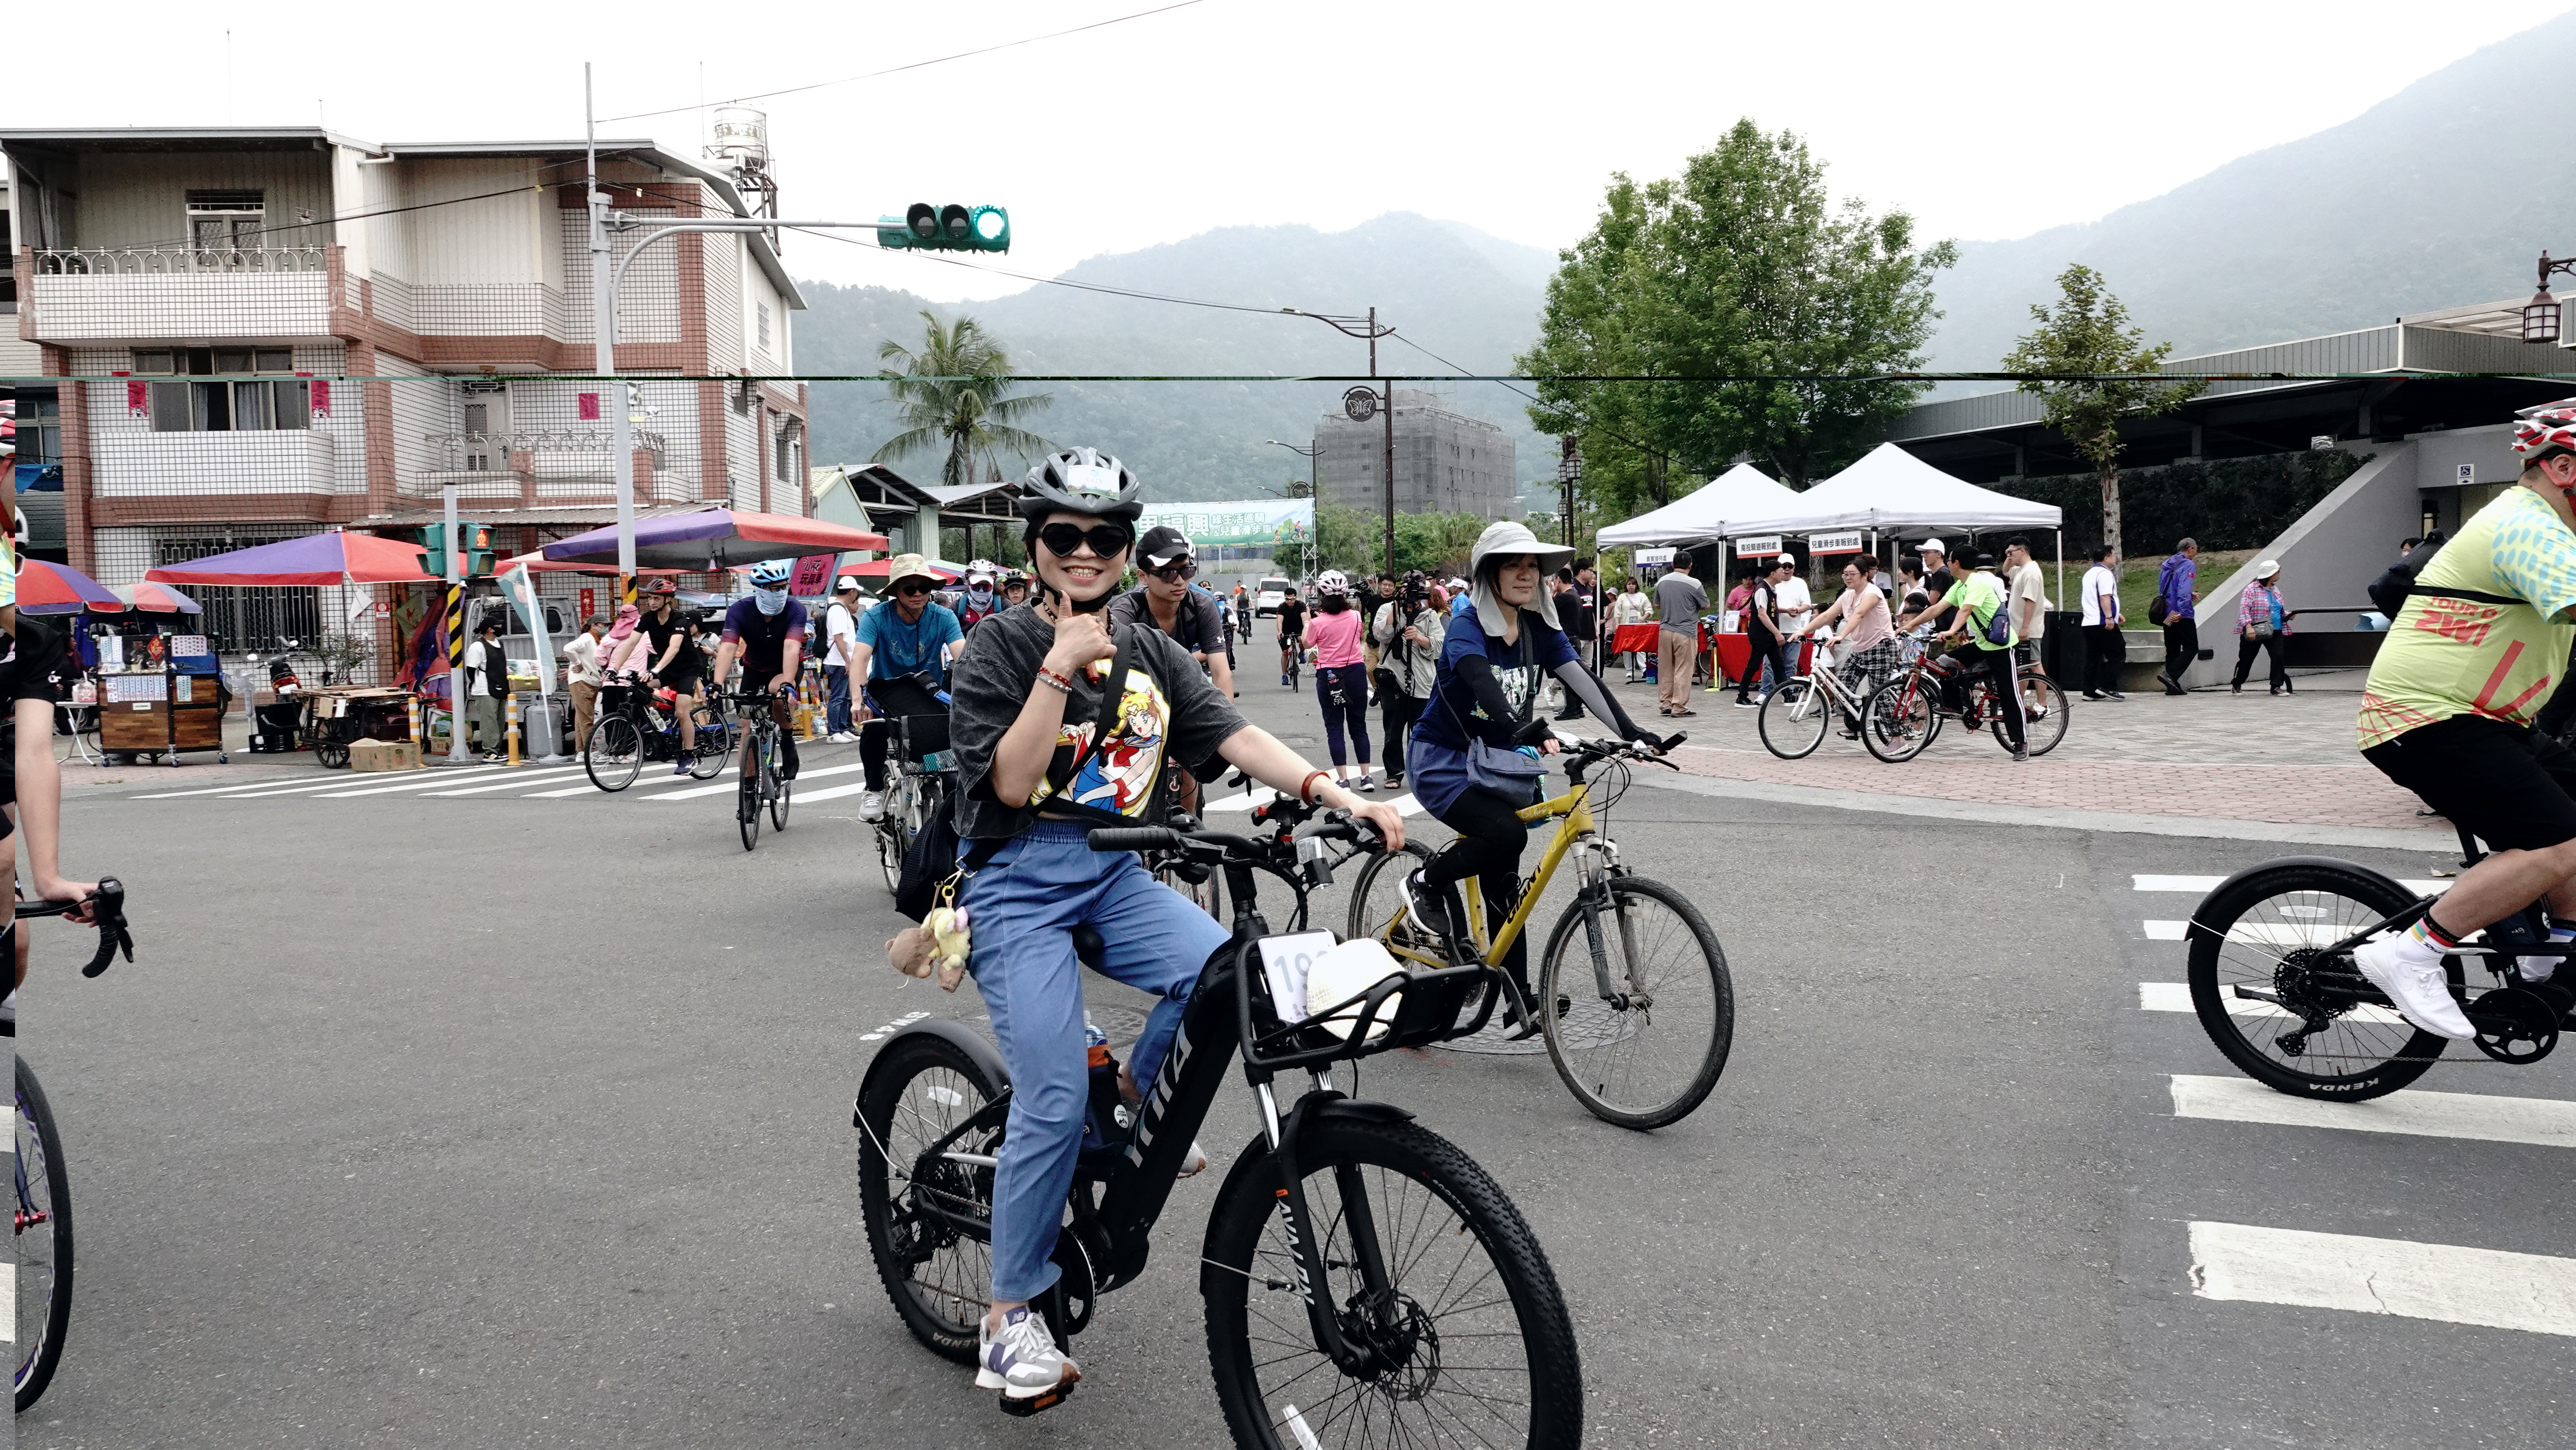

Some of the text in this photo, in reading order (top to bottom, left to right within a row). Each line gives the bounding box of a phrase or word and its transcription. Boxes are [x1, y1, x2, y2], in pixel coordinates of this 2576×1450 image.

[1211, 512, 1265, 525] 綠生活巡騎
[1811, 537, 1859, 549] 兒童滑步車報到處
[799, 573, 823, 585] 玩具車
[1507, 863, 1542, 924] GIANT
[1273, 950, 1328, 993] 19
[2309, 1077, 2379, 1092] KENDA
[1277, 1198, 1315, 1305] AVALON
